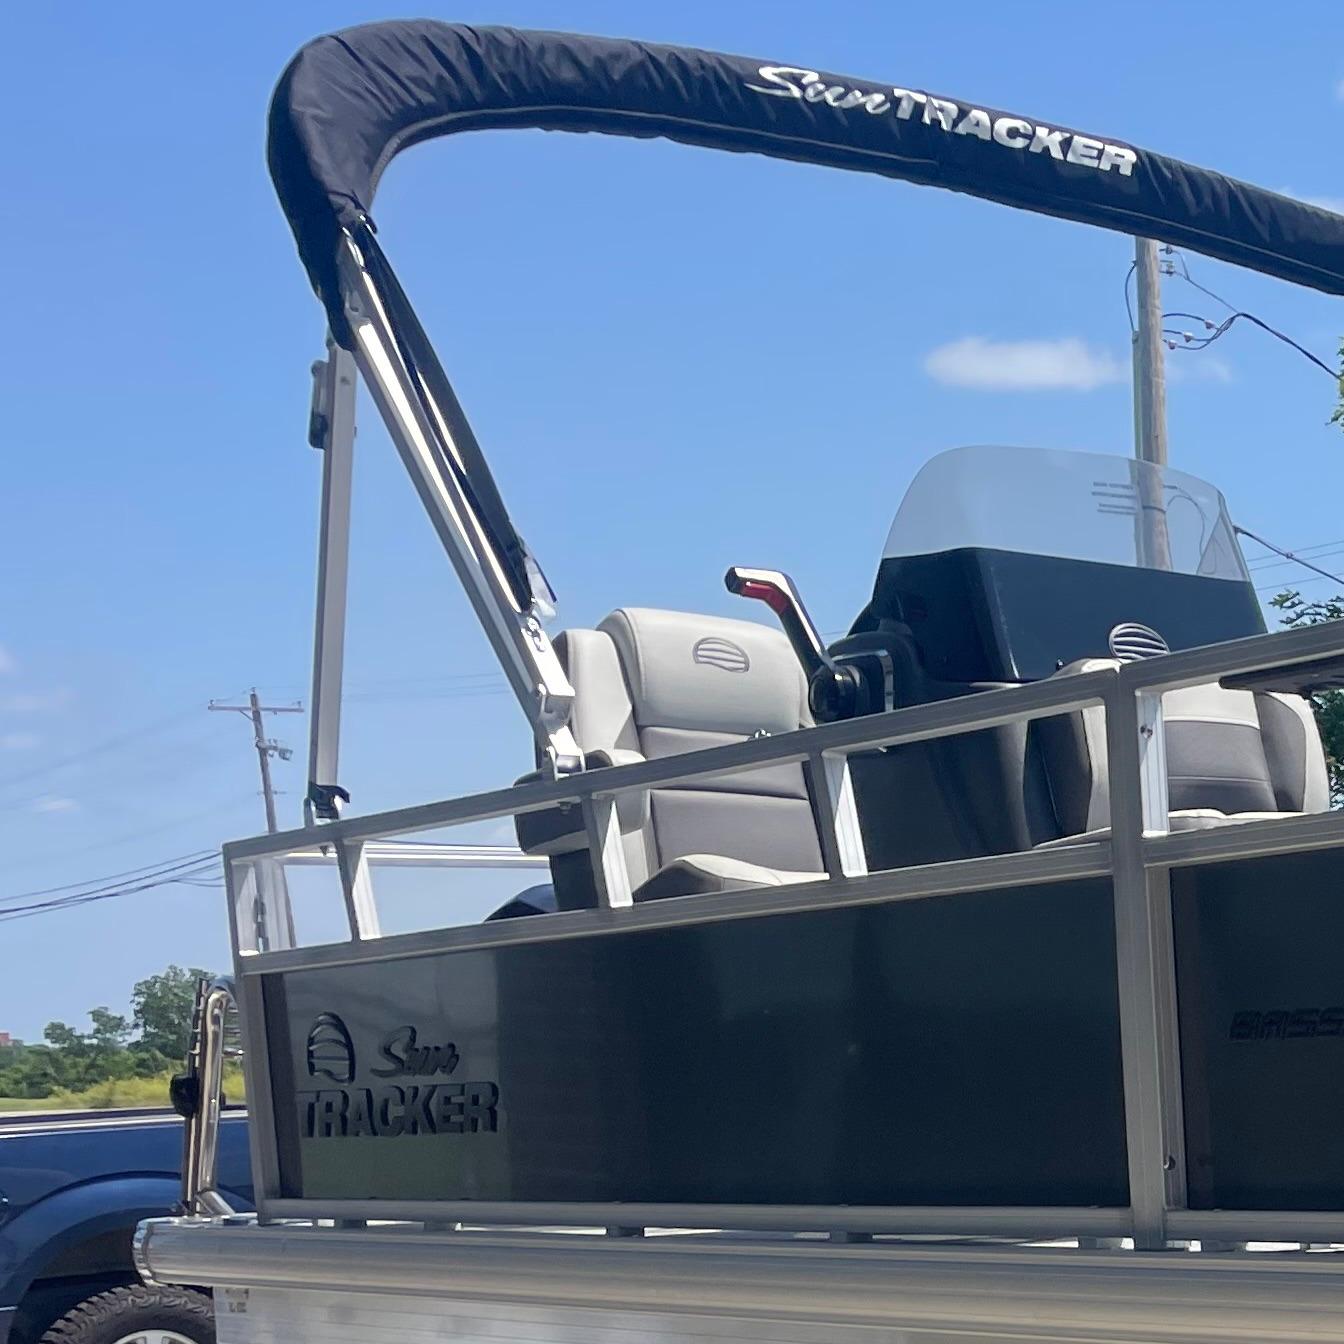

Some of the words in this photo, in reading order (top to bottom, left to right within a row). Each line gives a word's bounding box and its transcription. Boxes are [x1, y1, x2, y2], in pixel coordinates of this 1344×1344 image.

[744, 66, 890, 115] Sun
[893, 88, 1137, 176] TRACKER
[370, 1025, 460, 1078] Sun
[296, 1081, 500, 1138] TRACKER
